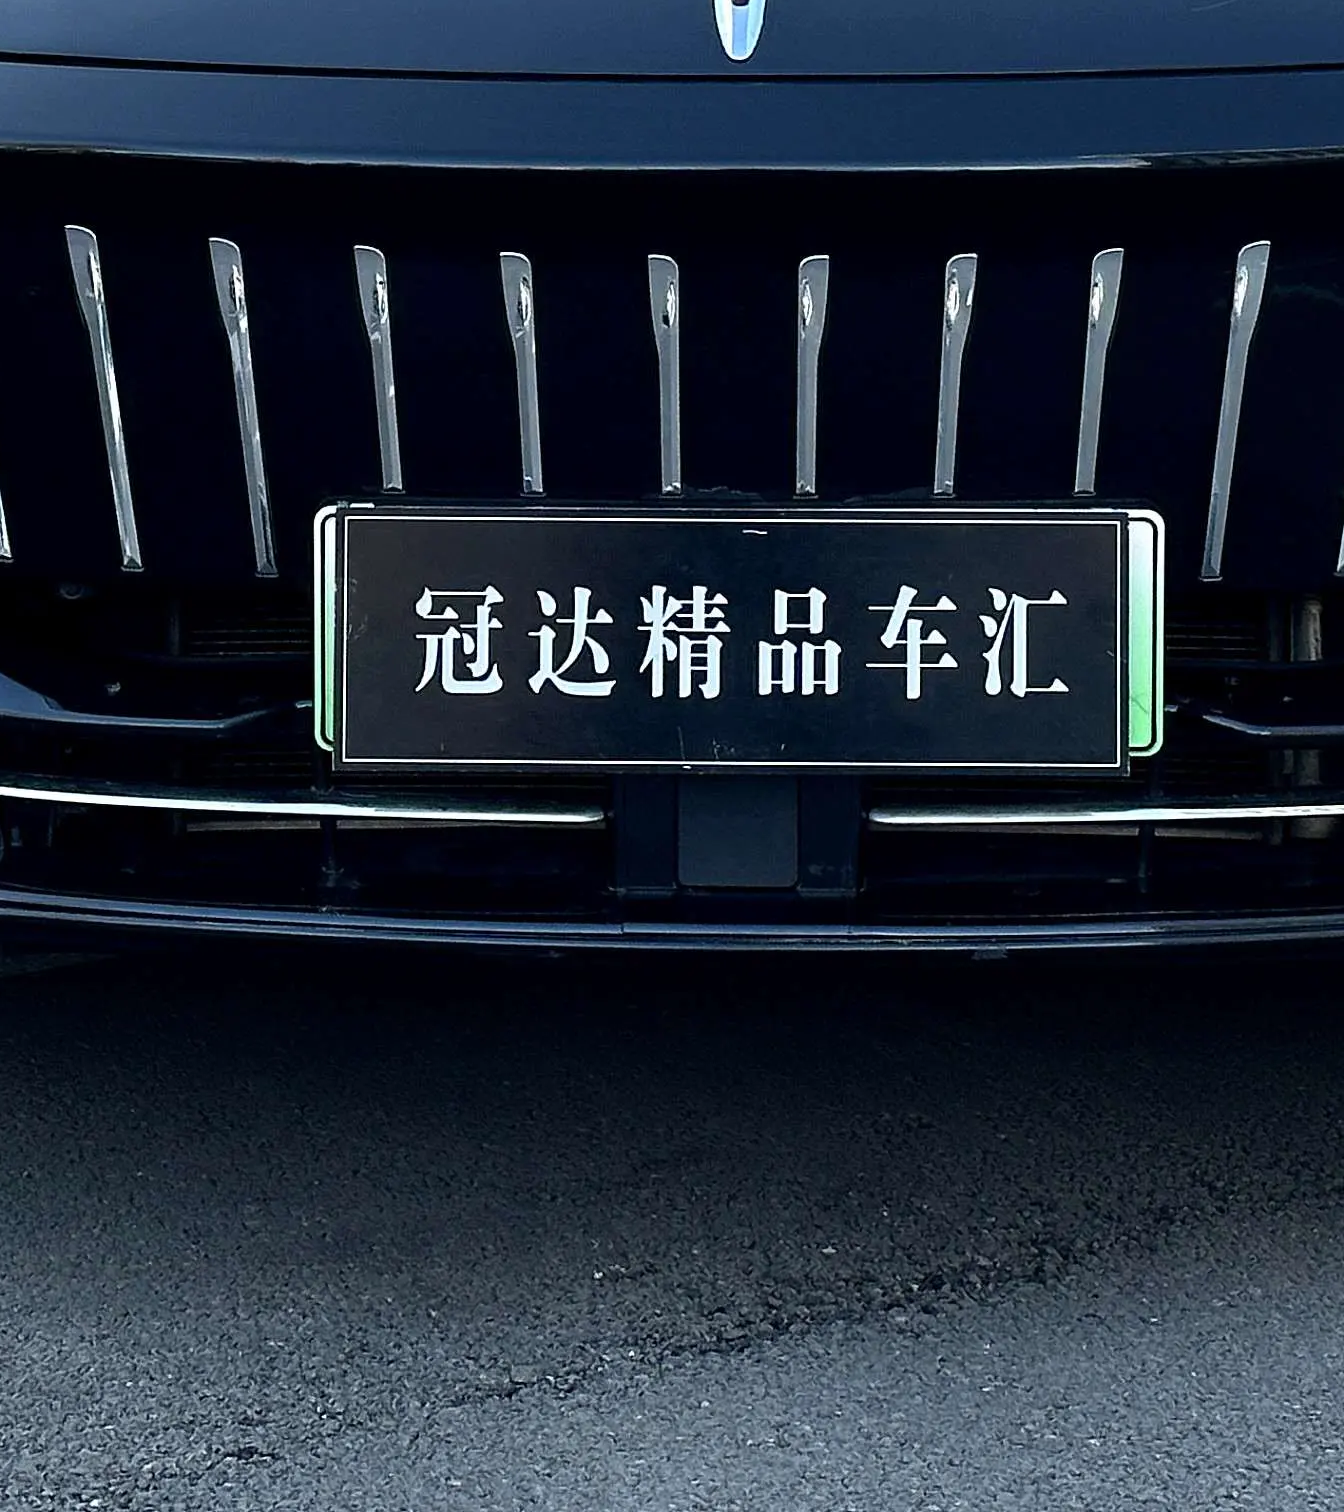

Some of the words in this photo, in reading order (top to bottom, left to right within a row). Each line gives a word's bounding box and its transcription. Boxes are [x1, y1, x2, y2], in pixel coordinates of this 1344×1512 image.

[414, 584, 1069, 700] 冠达精品车汇
